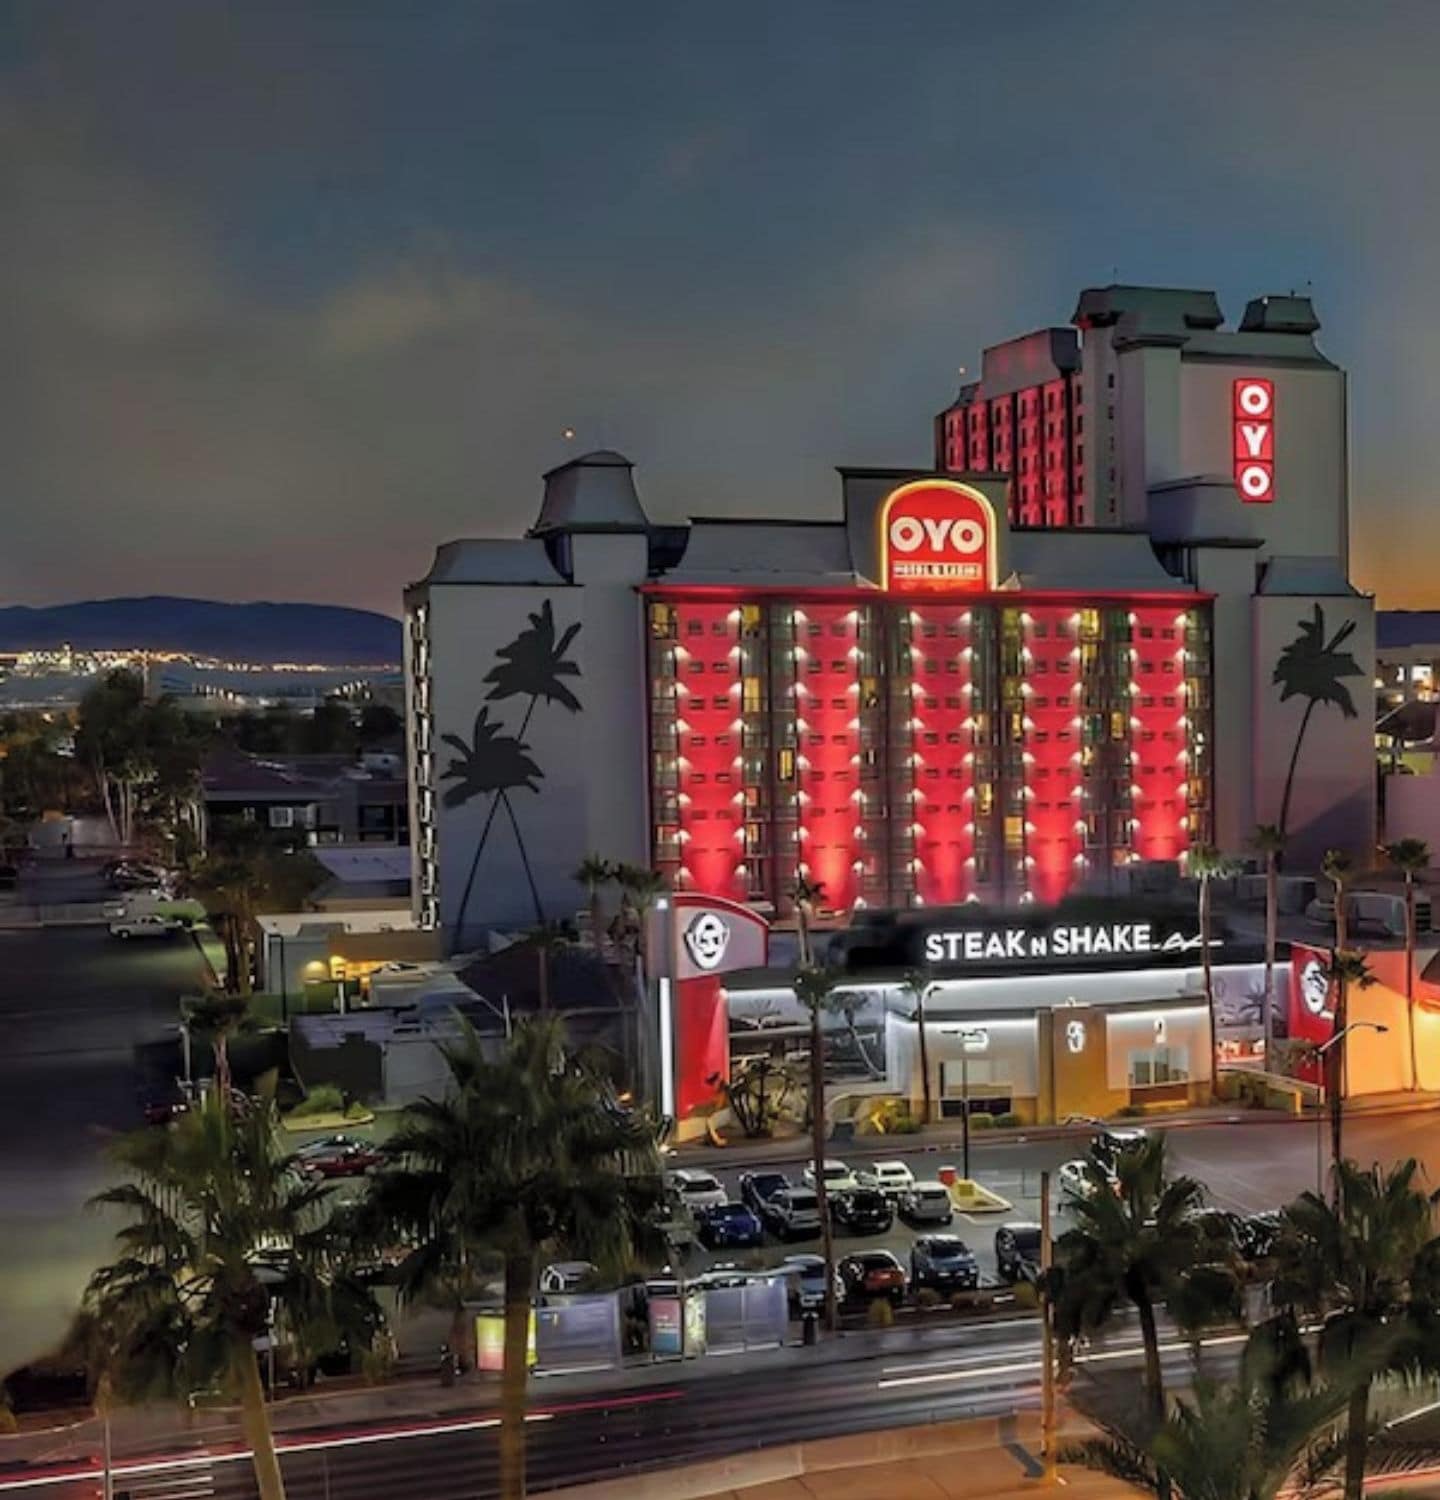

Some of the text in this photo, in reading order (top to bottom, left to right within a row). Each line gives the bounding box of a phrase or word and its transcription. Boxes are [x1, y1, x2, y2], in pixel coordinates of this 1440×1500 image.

[1240, 384, 1270, 497] OYO
[890, 516, 985, 554] OYO
[925, 924, 1151, 961] STEAK N SHAKE
